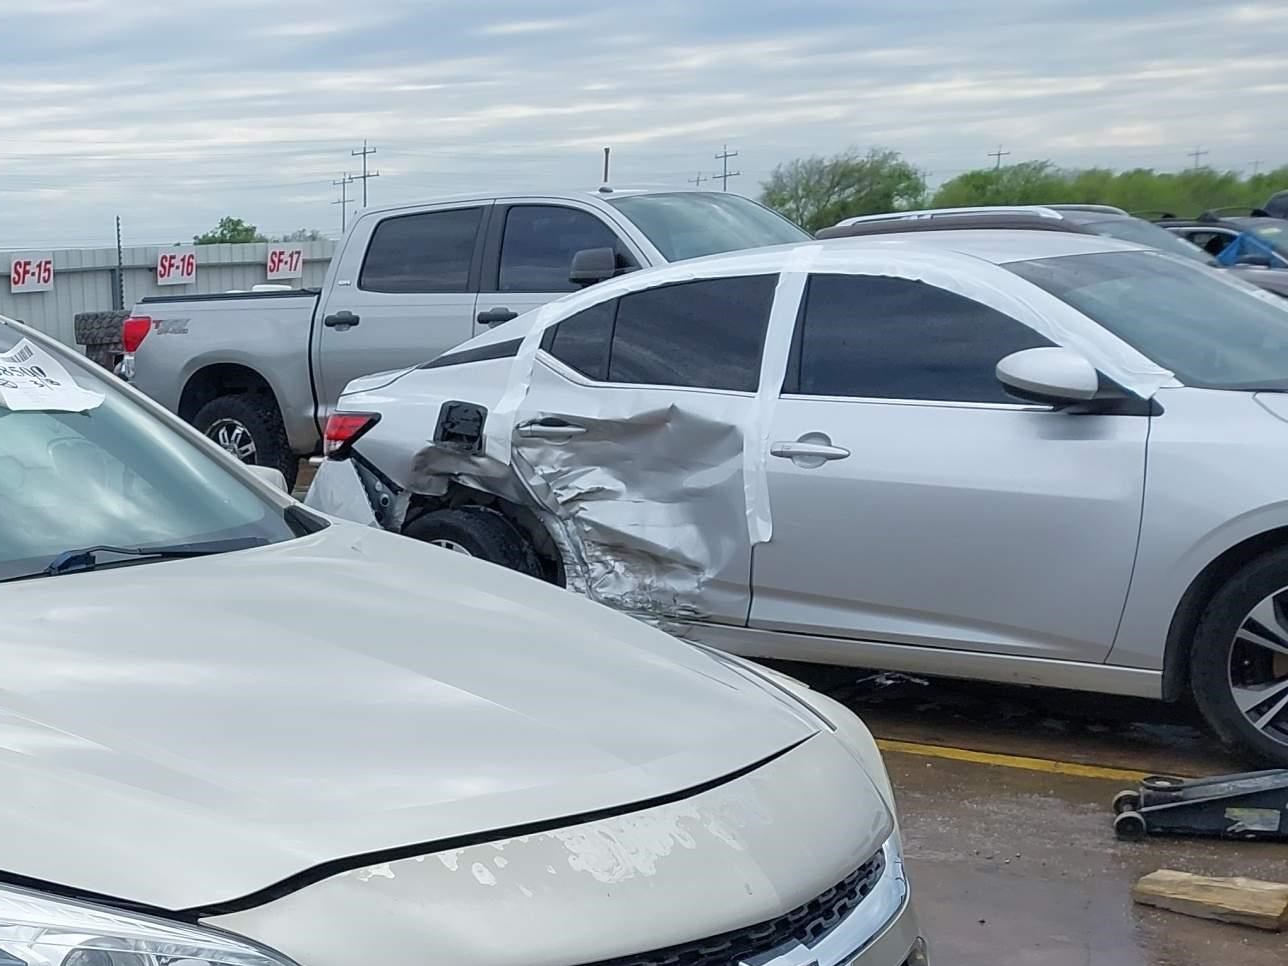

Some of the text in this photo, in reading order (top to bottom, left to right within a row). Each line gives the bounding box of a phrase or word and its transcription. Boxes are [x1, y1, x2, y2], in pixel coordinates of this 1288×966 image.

[12, 260, 52, 285] SF-15
[158, 254, 195, 278] SF-16
[269, 250, 301, 273] SF-17
